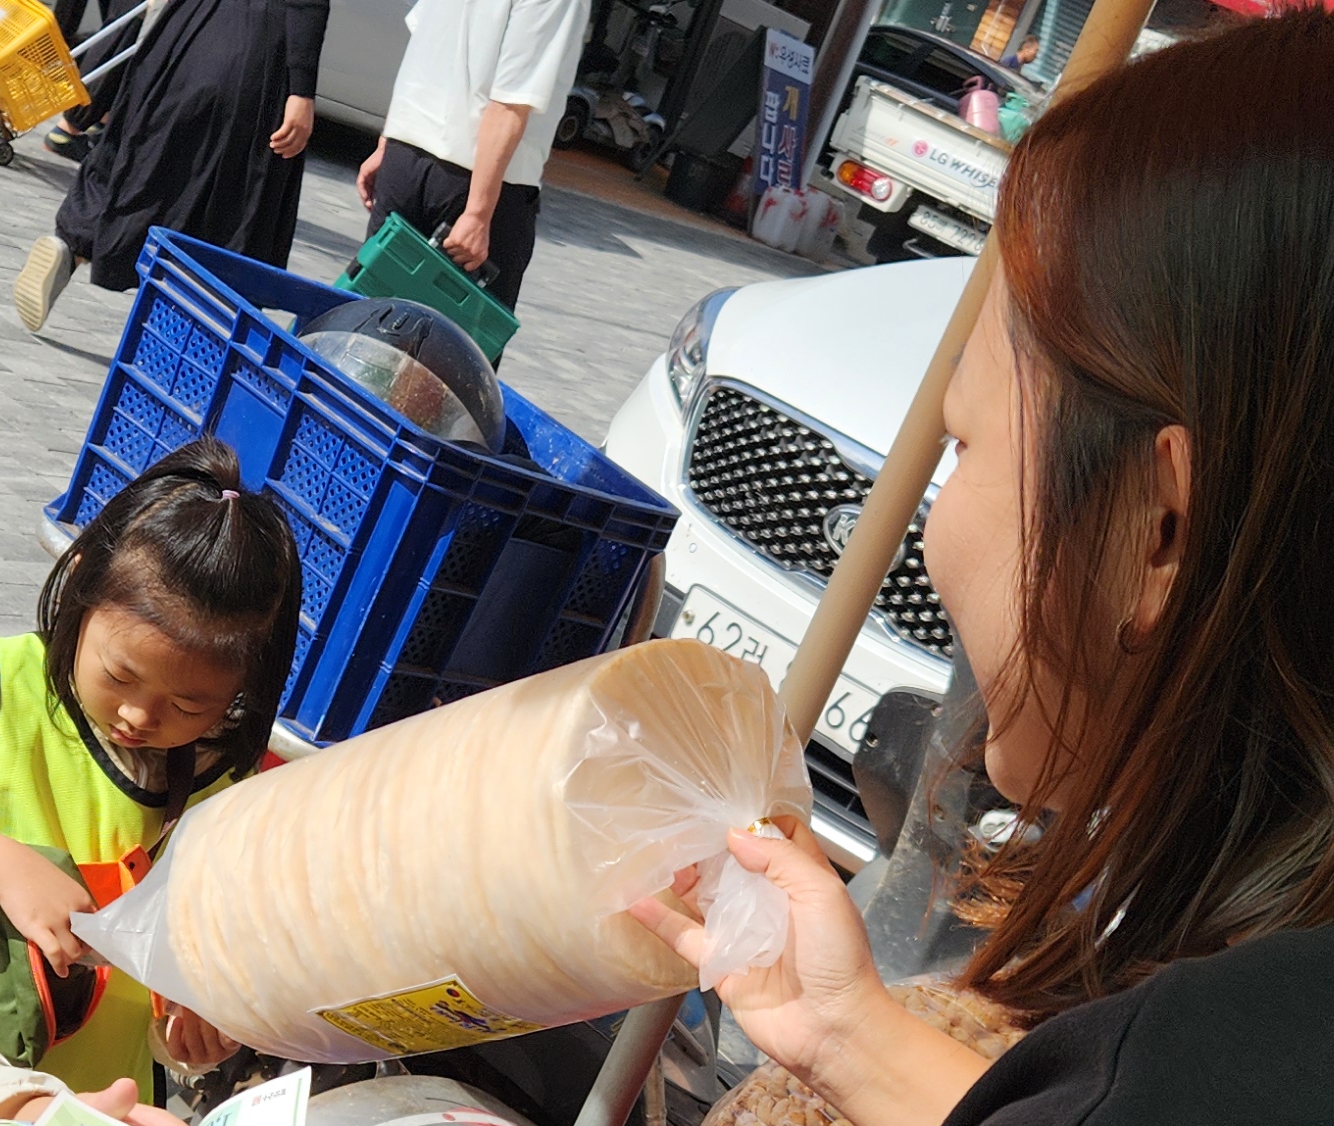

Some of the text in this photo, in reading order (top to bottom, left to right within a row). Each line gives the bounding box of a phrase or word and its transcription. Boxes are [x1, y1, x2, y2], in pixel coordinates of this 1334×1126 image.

[782, 85, 800, 121] 개
[760, 91, 781, 187] 팝니다
[930, 148, 949, 166] LG
